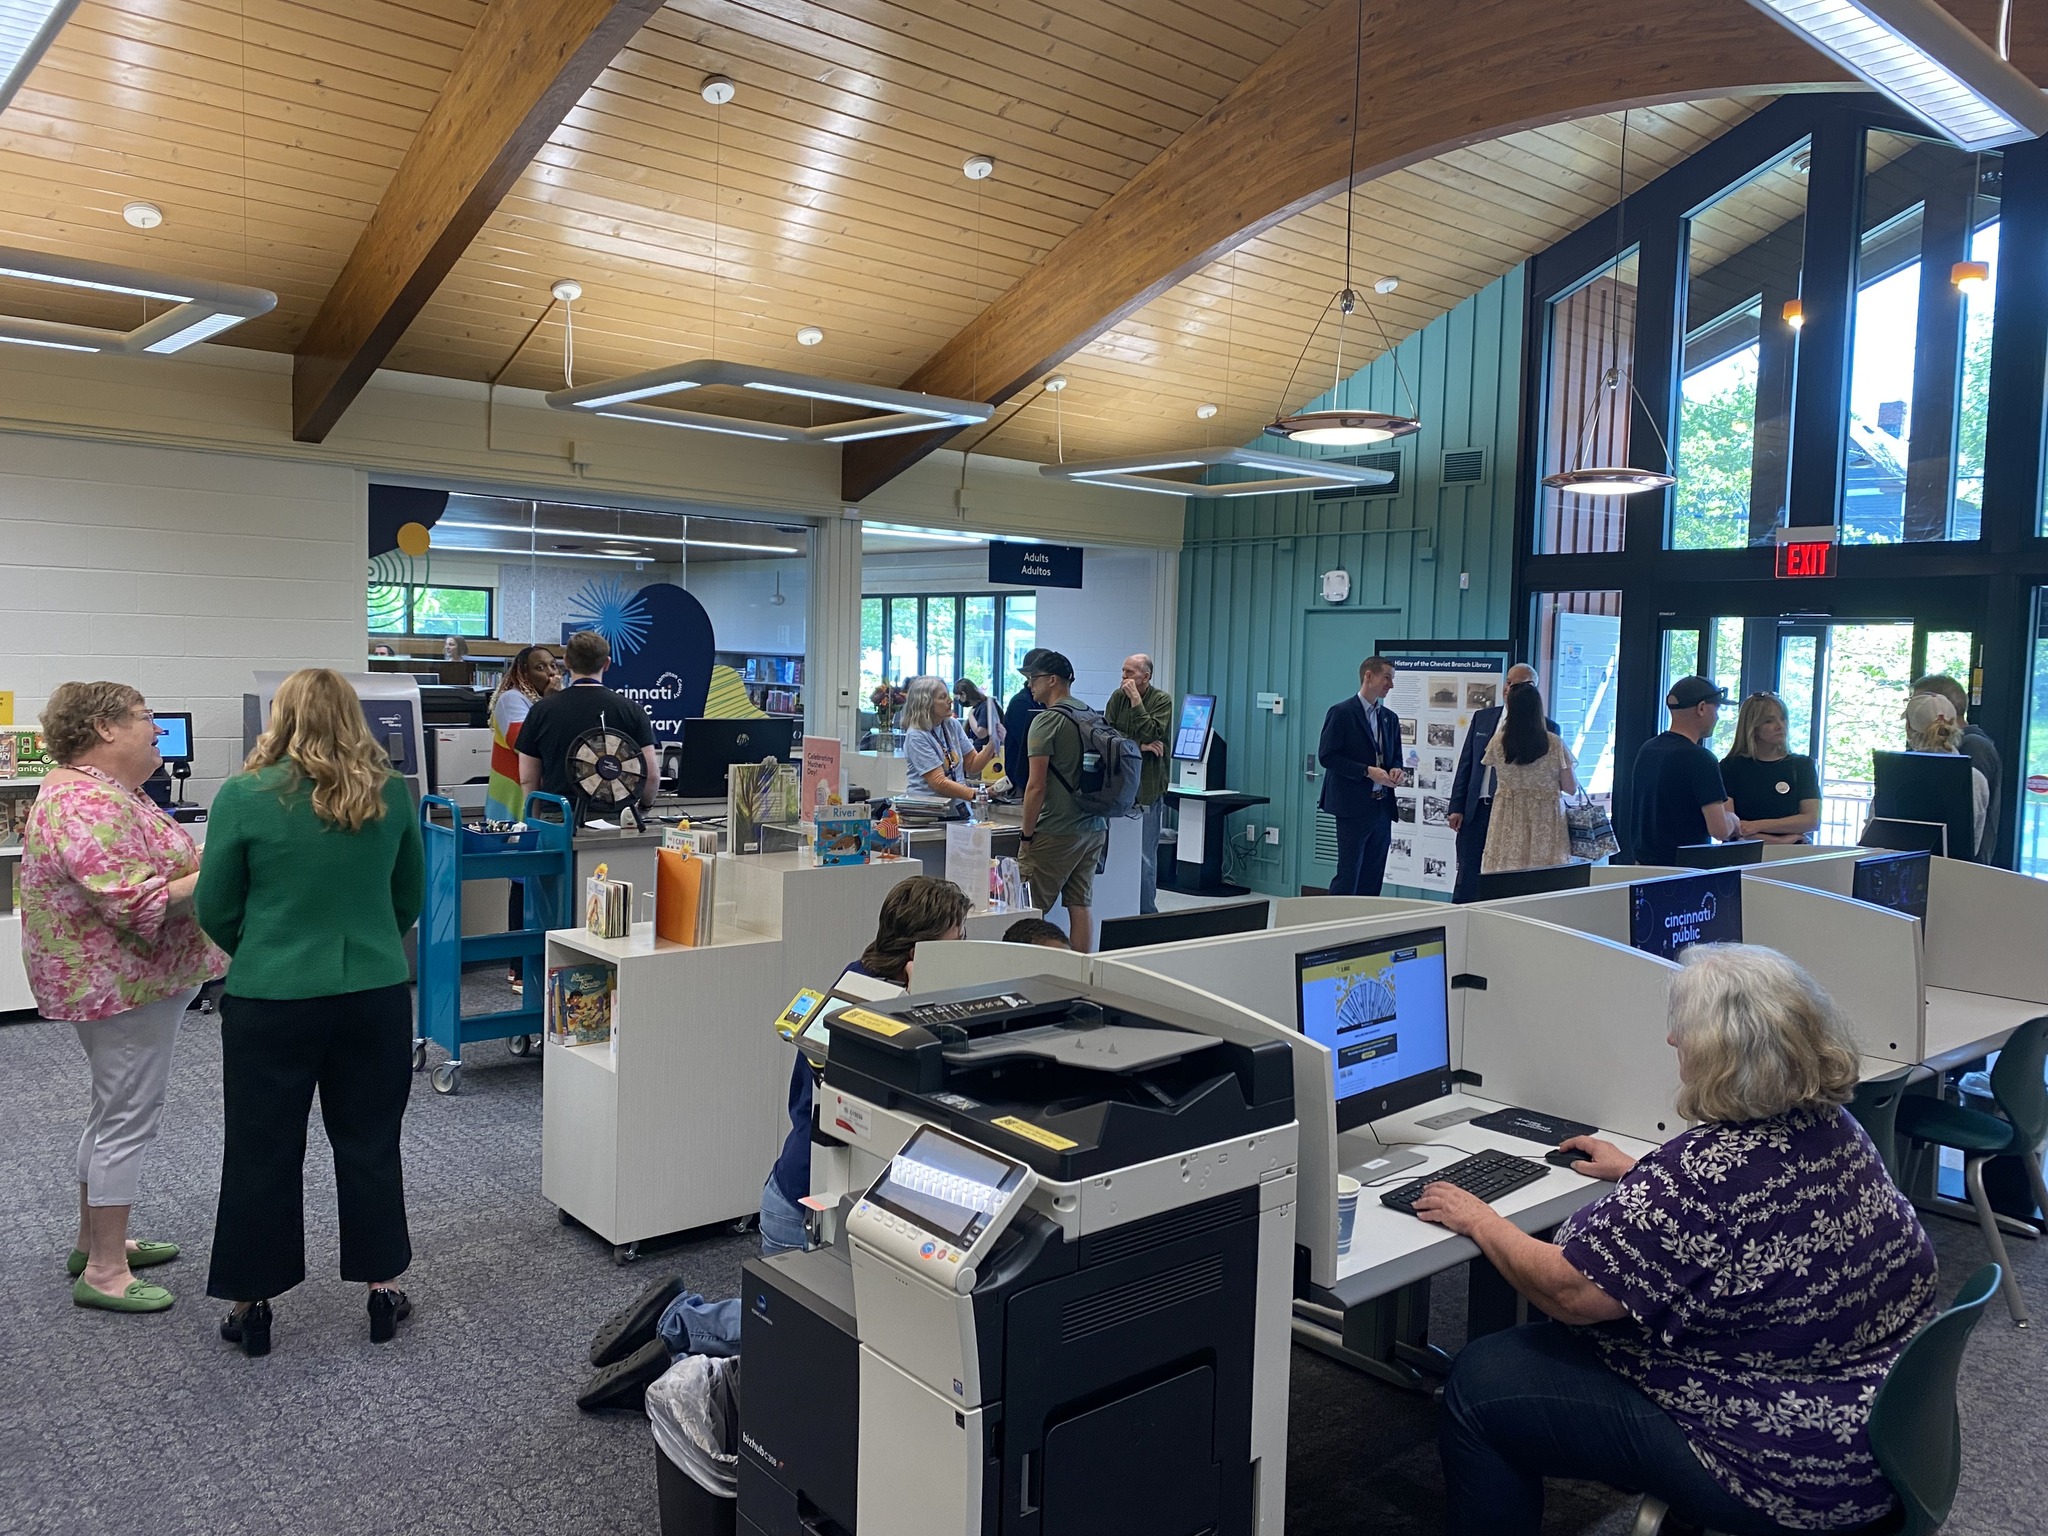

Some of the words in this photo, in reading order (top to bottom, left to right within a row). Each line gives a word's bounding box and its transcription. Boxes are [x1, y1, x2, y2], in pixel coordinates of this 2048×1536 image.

[1023, 552, 1049, 563] Adults
[1787, 543, 1830, 576] EXIT
[1021, 565, 1051, 576] Adultos
[1394, 660, 1413, 668] History
[1471, 662, 1492, 670] Library
[655, 671, 678, 686] Hamilton
[609, 684, 672, 700] cinnati
[650, 719, 682, 734] rary
[807, 752, 834, 764] Celebrating
[17, 765, 50, 774] anley's
[807, 760, 826, 769] Mother's
[807, 768, 818, 776] Day!
[833, 807, 857, 818] River
[1664, 905, 1711, 928] cincinnati
[1672, 926, 1701, 948] public
[742, 1431, 765, 1457] bizhub
